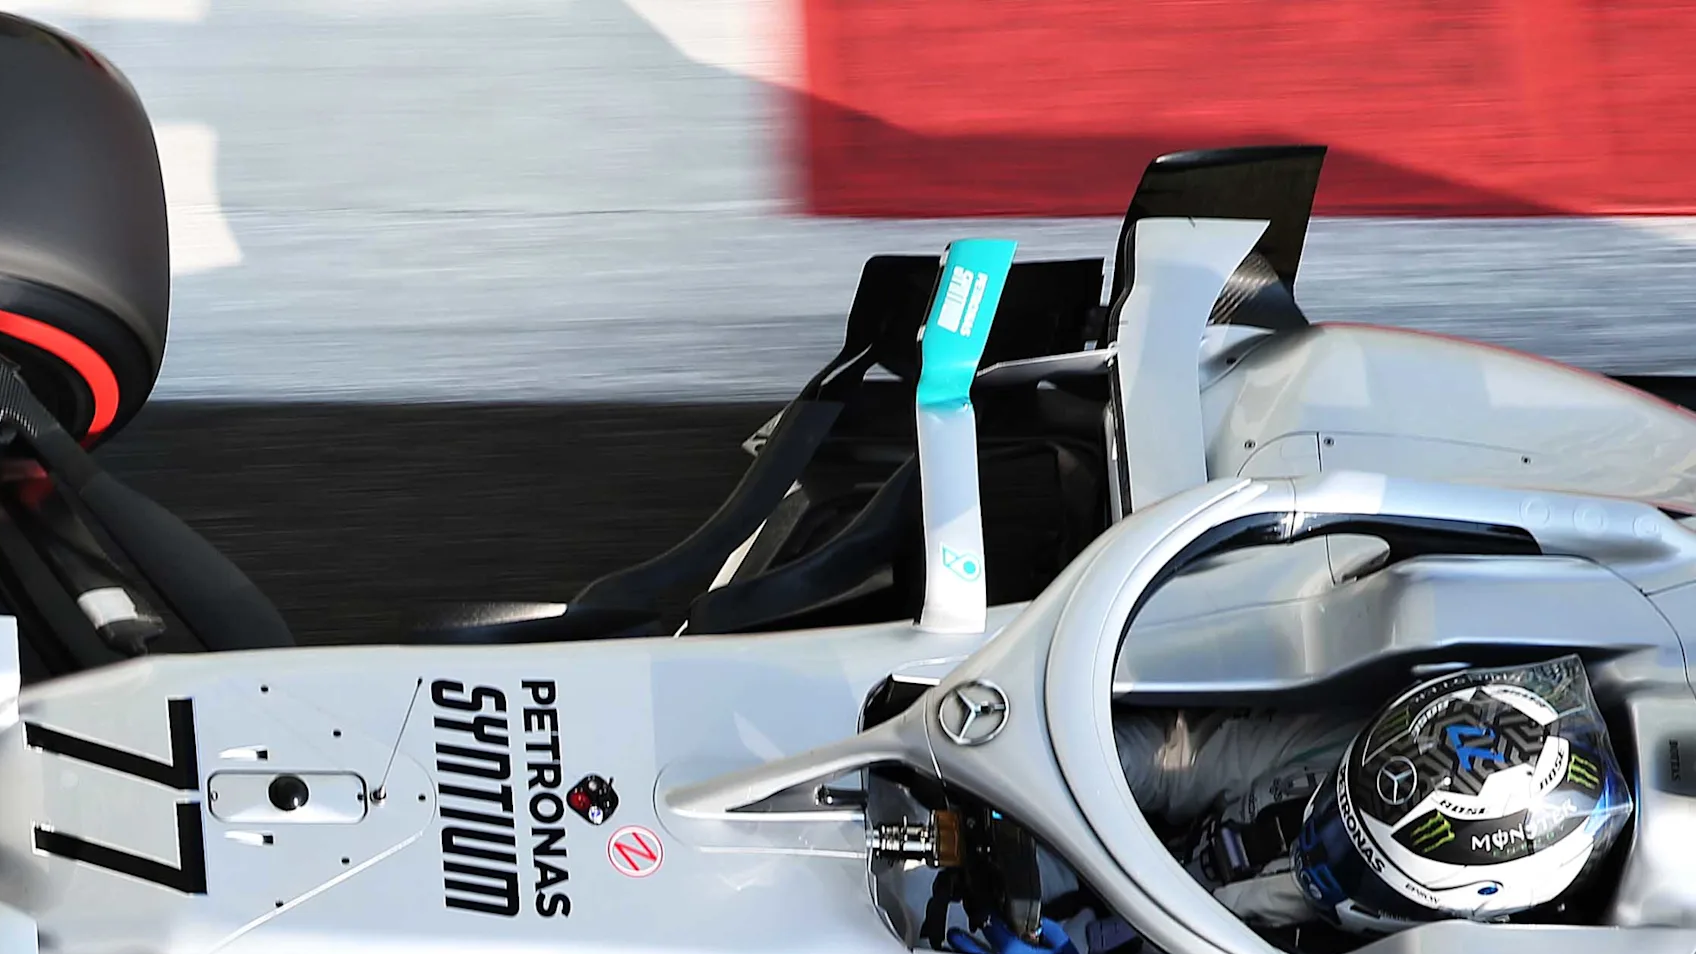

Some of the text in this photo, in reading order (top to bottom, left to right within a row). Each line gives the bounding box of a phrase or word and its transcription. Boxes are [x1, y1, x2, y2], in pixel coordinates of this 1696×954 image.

[24, 698, 209, 896] 77
[430, 679, 521, 918] SYNTIUM
[521, 679, 571, 919] PETRONAS
